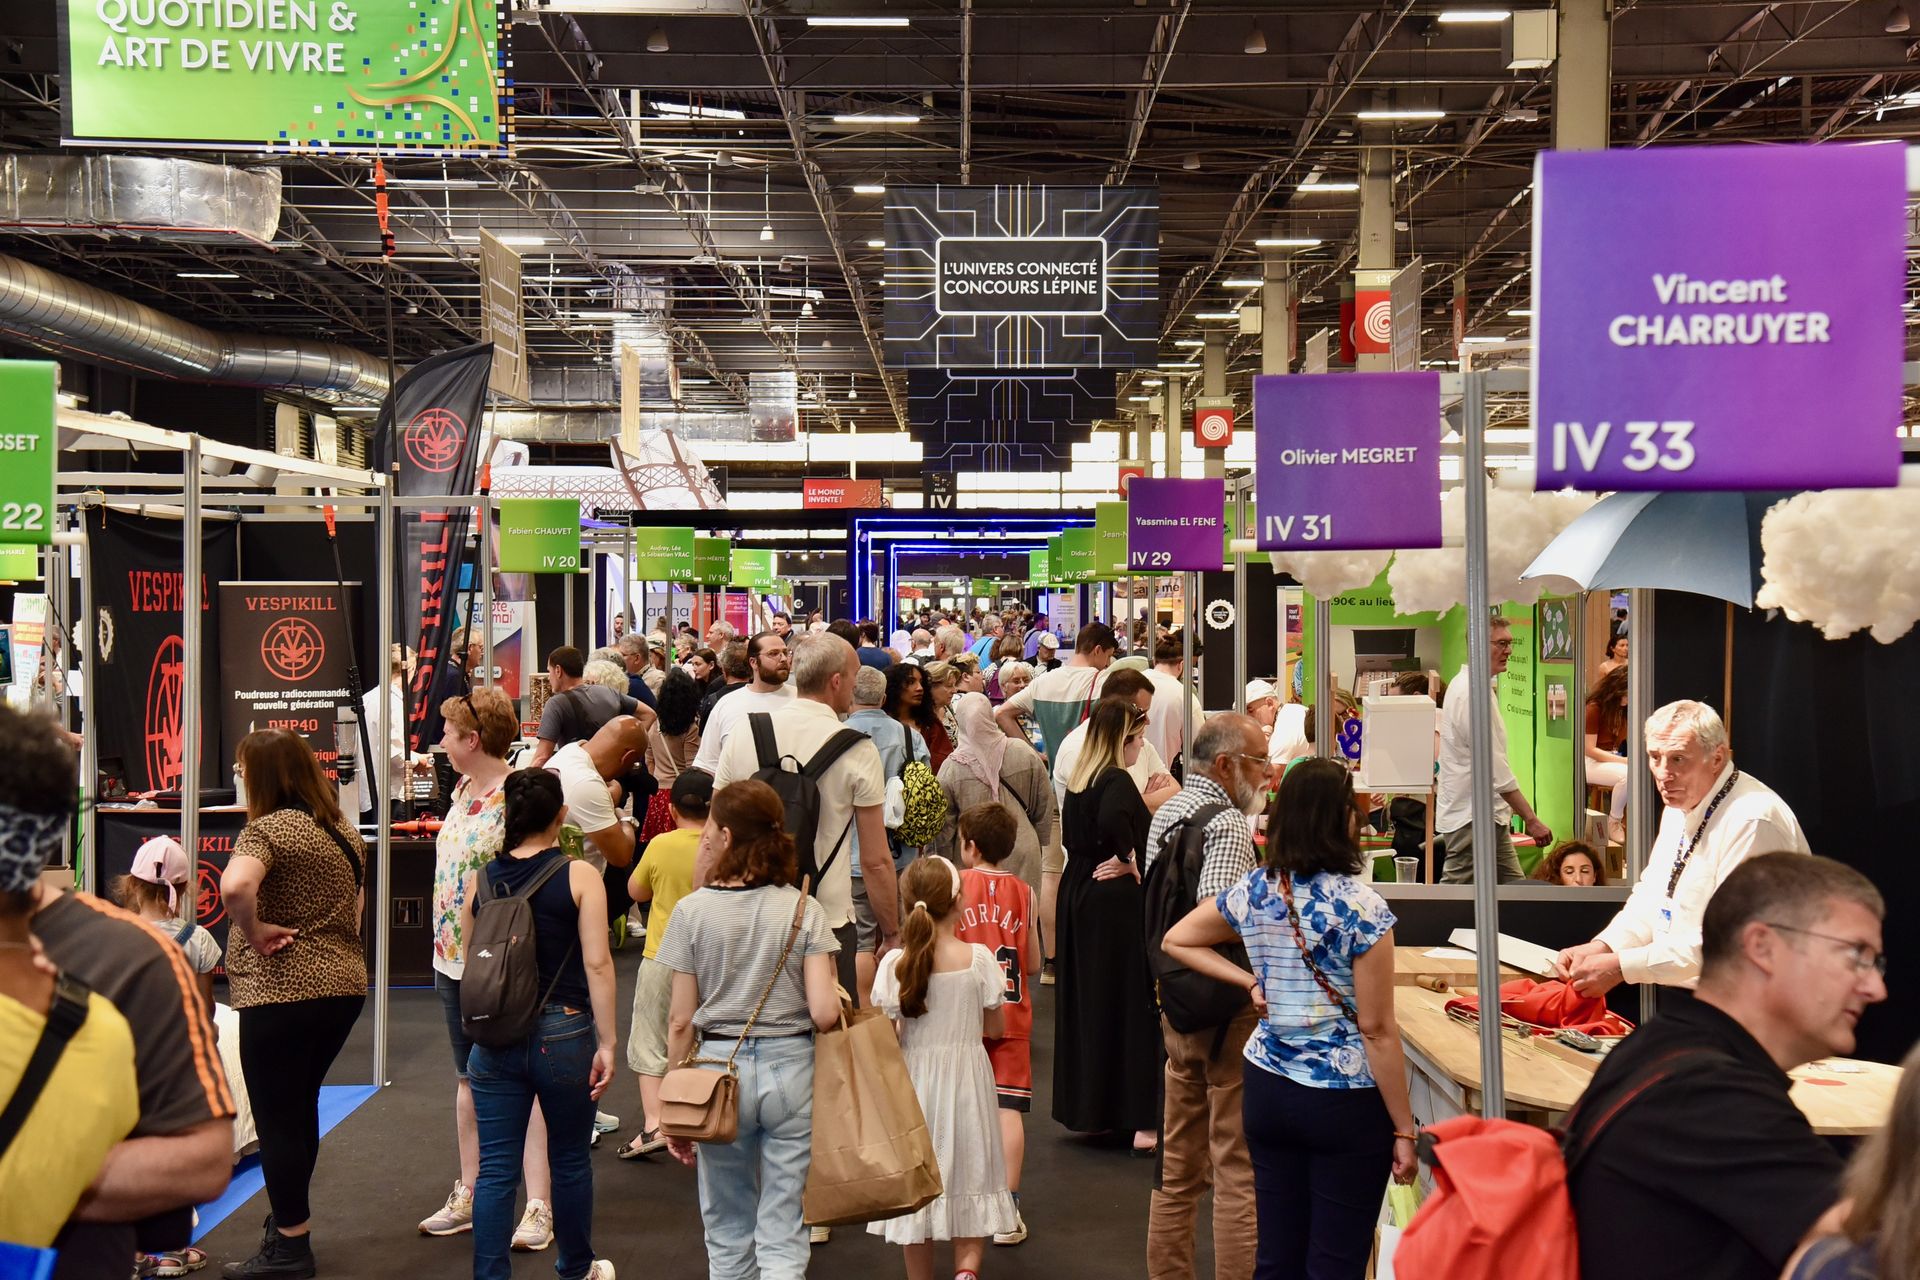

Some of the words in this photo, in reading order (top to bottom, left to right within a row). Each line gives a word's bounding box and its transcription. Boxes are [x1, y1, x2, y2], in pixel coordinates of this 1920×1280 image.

[95, 0, 320, 33] QUOTIDIEN
[327, 0, 357, 31] &
[98, 37, 171, 68] ART
[181, 39, 231, 69] DE
[239, 41, 346, 73] VIVRE
[944, 262, 1014, 275] L'UNIVERS
[1017, 259, 1097, 275] CONNECTÉ
[944, 280, 1039, 295] CONCOURS
[1043, 277, 1097, 295] LÉPINE
[1652, 273, 1788, 304] Vincent
[1608, 312, 1830, 348] CHARRUYER
[1552, 422, 1610, 472] IV
[1623, 421, 1696, 472] 33
[1280, 449, 1338, 465] Olivier
[1342, 447, 1418, 464] MEGRET
[930, 494, 952, 509] IV
[2, 502, 44, 530] 22
[1136, 517, 1178, 526] Yassmina
[1180, 517, 1190, 526] EL
[1192, 517, 1217, 526] FENE
[508, 527, 533, 535] Fabien
[534, 527, 572, 535] CHAUVET
[1265, 515, 1295, 542] IV
[1301, 514, 1333, 541] 31
[543, 556, 555, 567] IV
[559, 556, 576, 567] 20
[1132, 551, 1148, 566] IV
[1151, 551, 1172, 566] 29
[670, 569, 679, 577] IV
[681, 569, 691, 578] 18
[1064, 571, 1074, 580] IV
[1076, 571, 1088, 580] 25
[245, 597, 337, 611] VESPIKILL
[235, 690, 280, 700] Poudreuse
[253, 700, 288, 710] nouvelle
[290, 699, 335, 711] génération
[960, 903, 1023, 934] JORDAN
